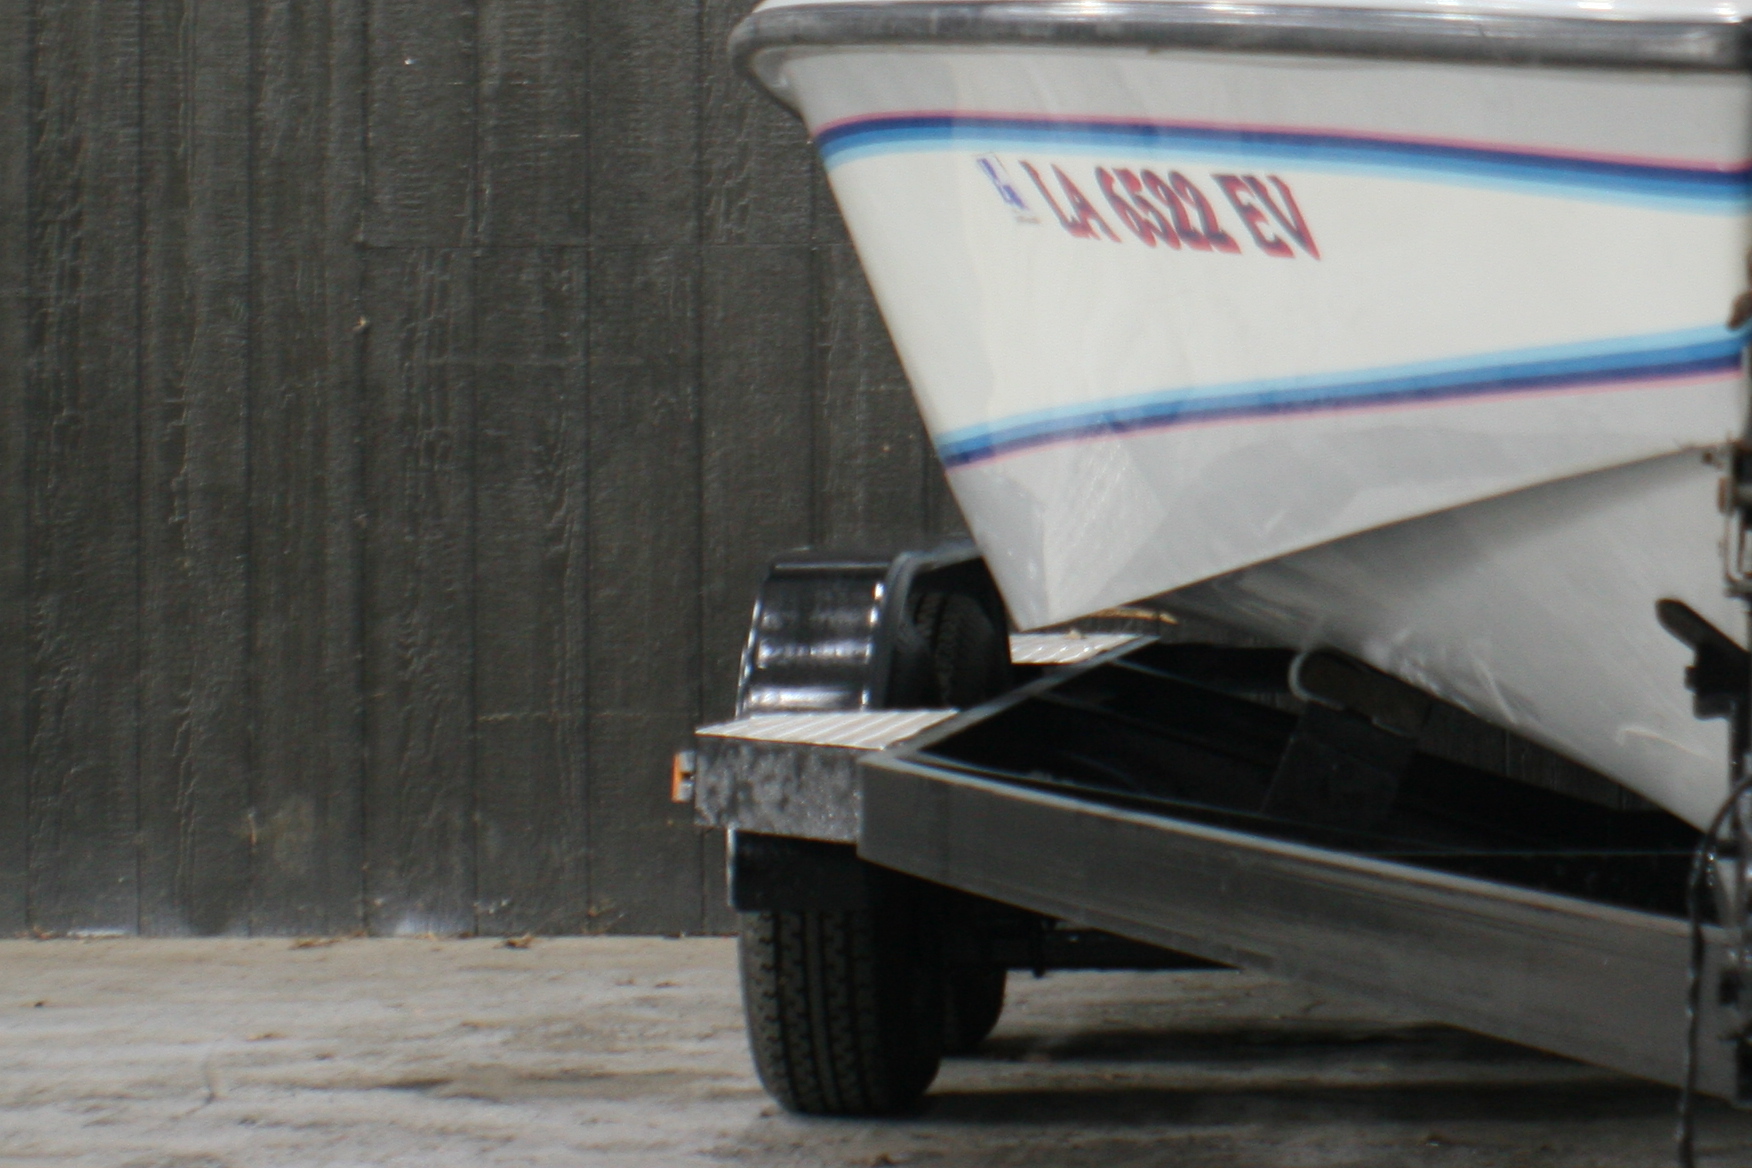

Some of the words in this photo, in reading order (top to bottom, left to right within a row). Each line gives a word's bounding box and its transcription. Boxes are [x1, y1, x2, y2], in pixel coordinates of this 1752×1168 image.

[1018, 159, 1122, 243] LA
[1094, 166, 1241, 251] 6522
[1210, 173, 1321, 261] EV
